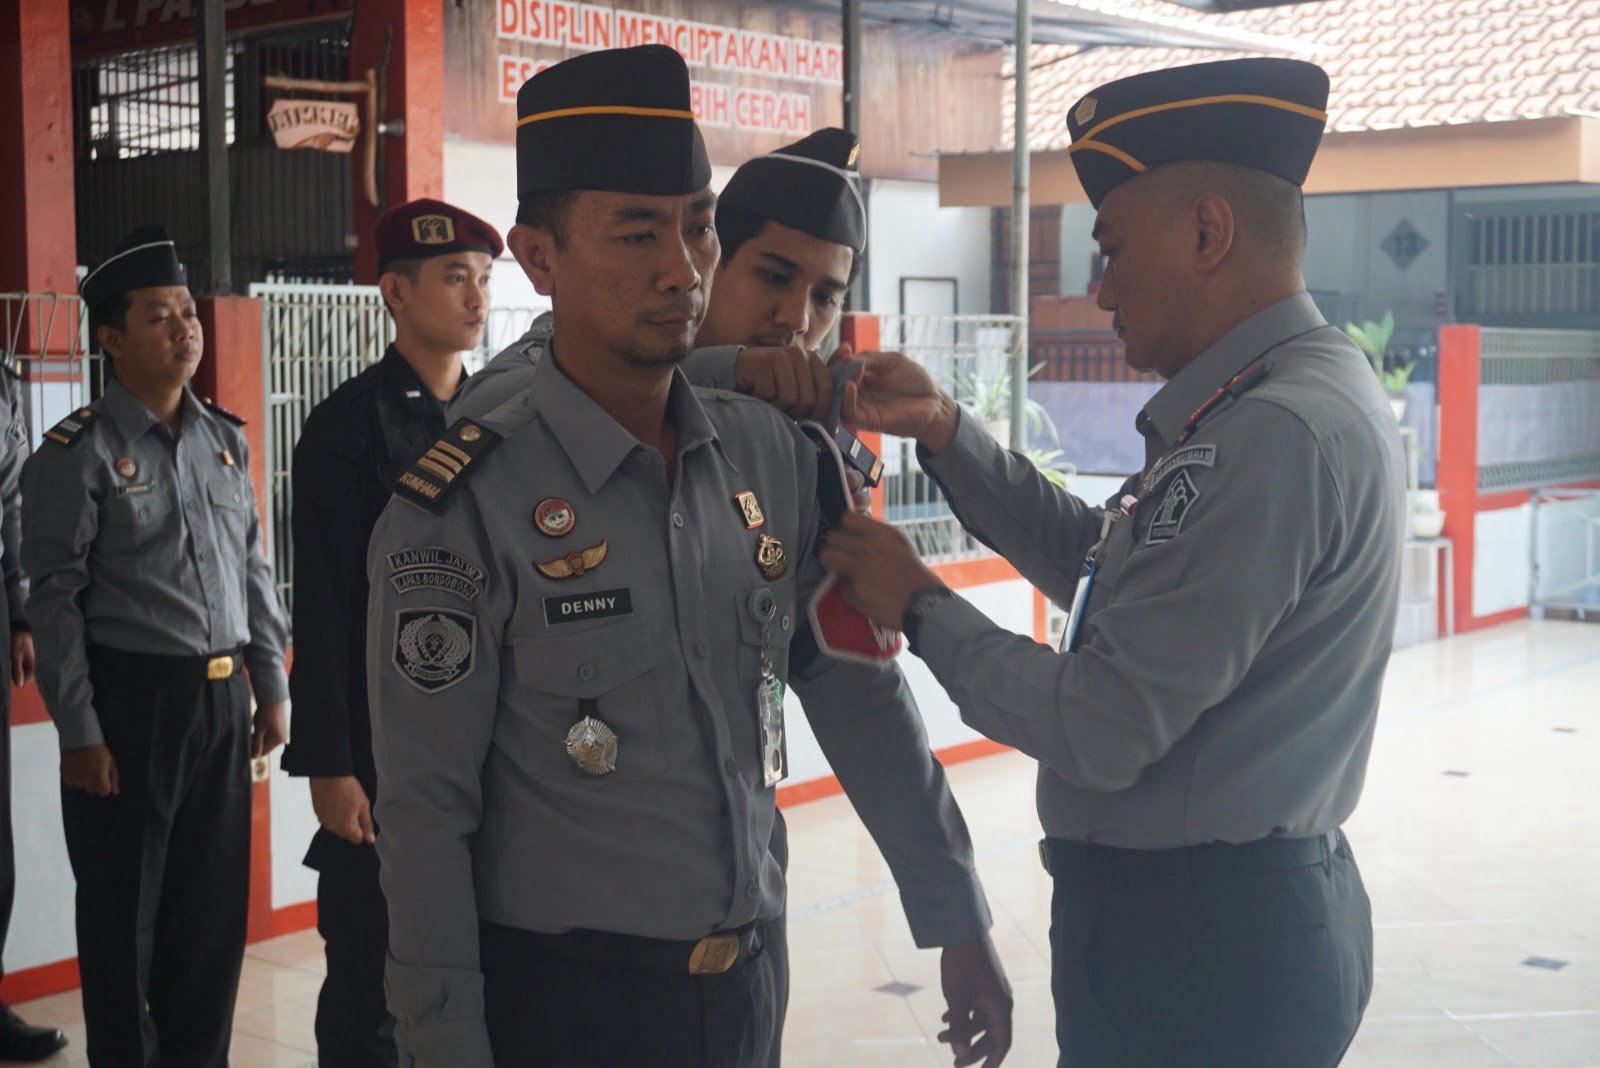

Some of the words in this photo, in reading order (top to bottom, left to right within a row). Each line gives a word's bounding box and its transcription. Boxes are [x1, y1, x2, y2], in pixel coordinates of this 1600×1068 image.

[500, 0, 610, 48] DISIPLIN
[618, 15, 787, 73] MENCIPTAKAN
[691, 85, 728, 123] BIH
[736, 91, 810, 131] CERAH
[395, 550, 441, 567] KANWIL
[398, 574, 420, 589] LAPAS
[561, 597, 616, 615] DENNY
